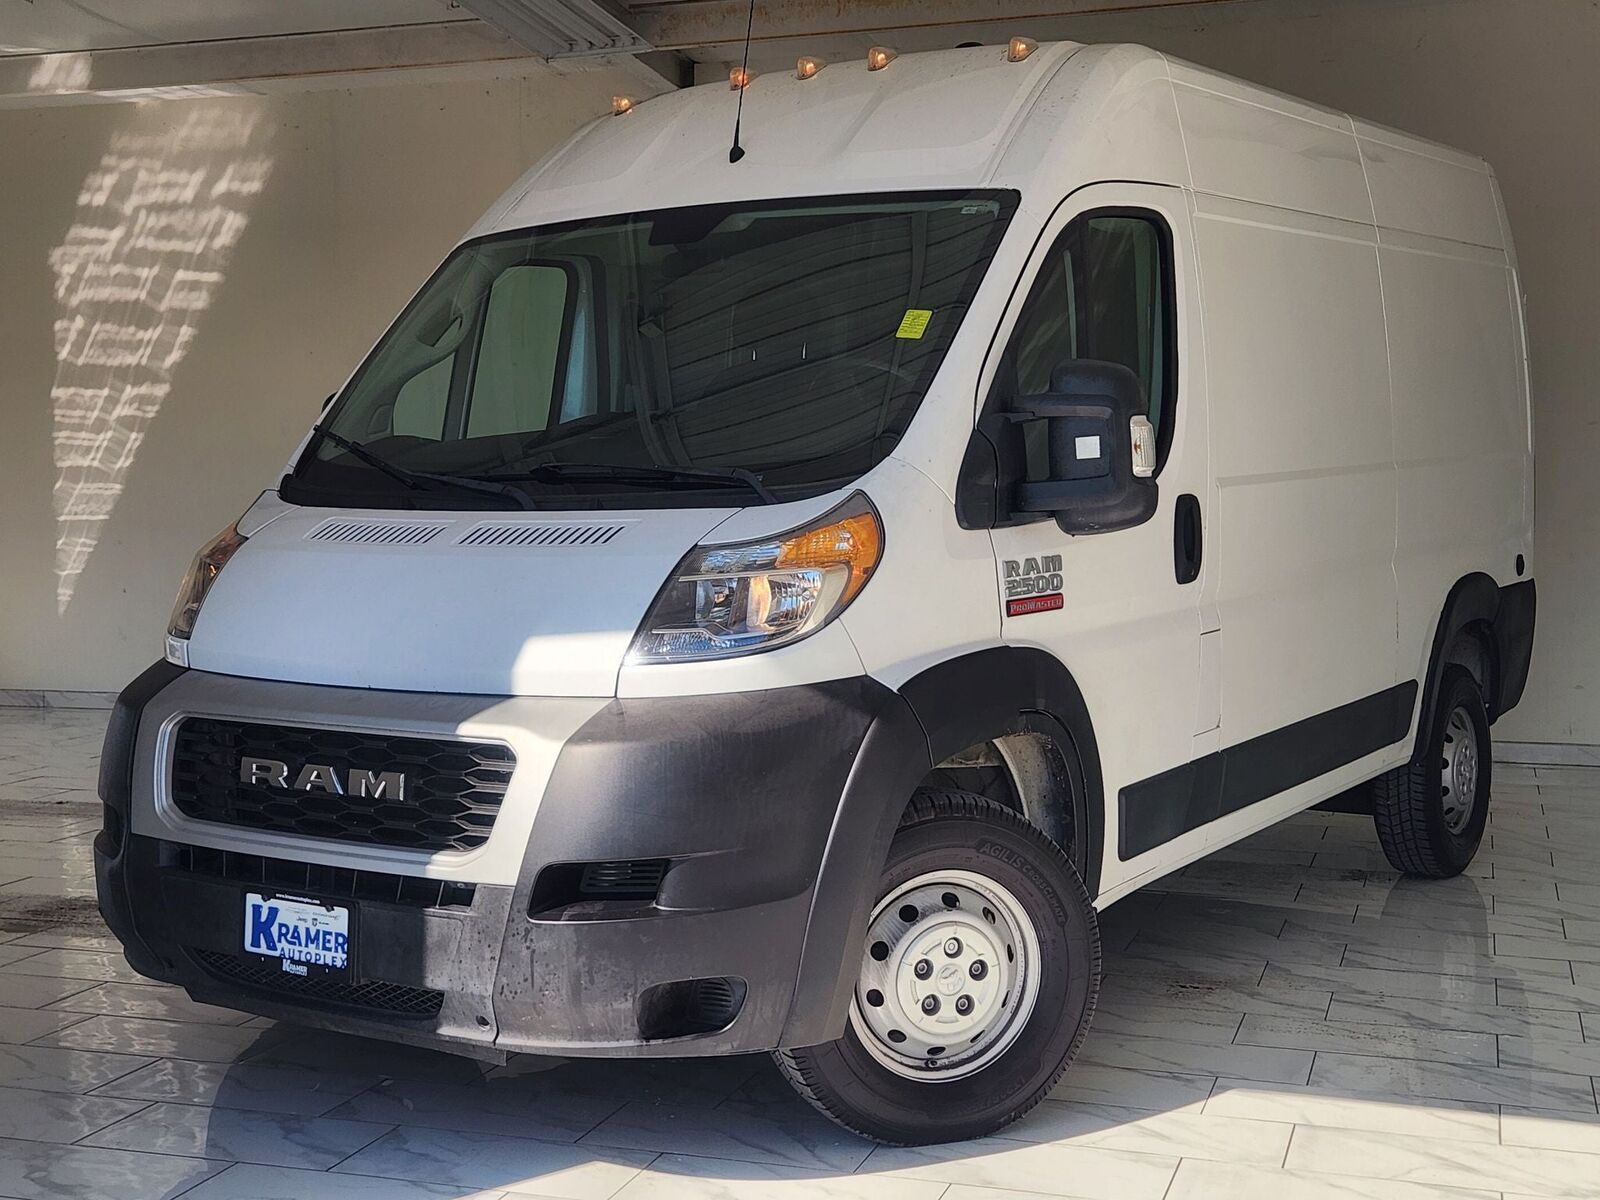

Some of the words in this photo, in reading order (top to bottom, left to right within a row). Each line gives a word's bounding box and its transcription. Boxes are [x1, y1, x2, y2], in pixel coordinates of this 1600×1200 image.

[1002, 554, 1063, 579] RAM
[1004, 573, 1064, 598] 2500
[240, 756, 405, 801] RAM
[979, 842, 1025, 869] AGILIS
[250, 903, 347, 954] KRAMER
[280, 946, 347, 969] AUTOPLEX
